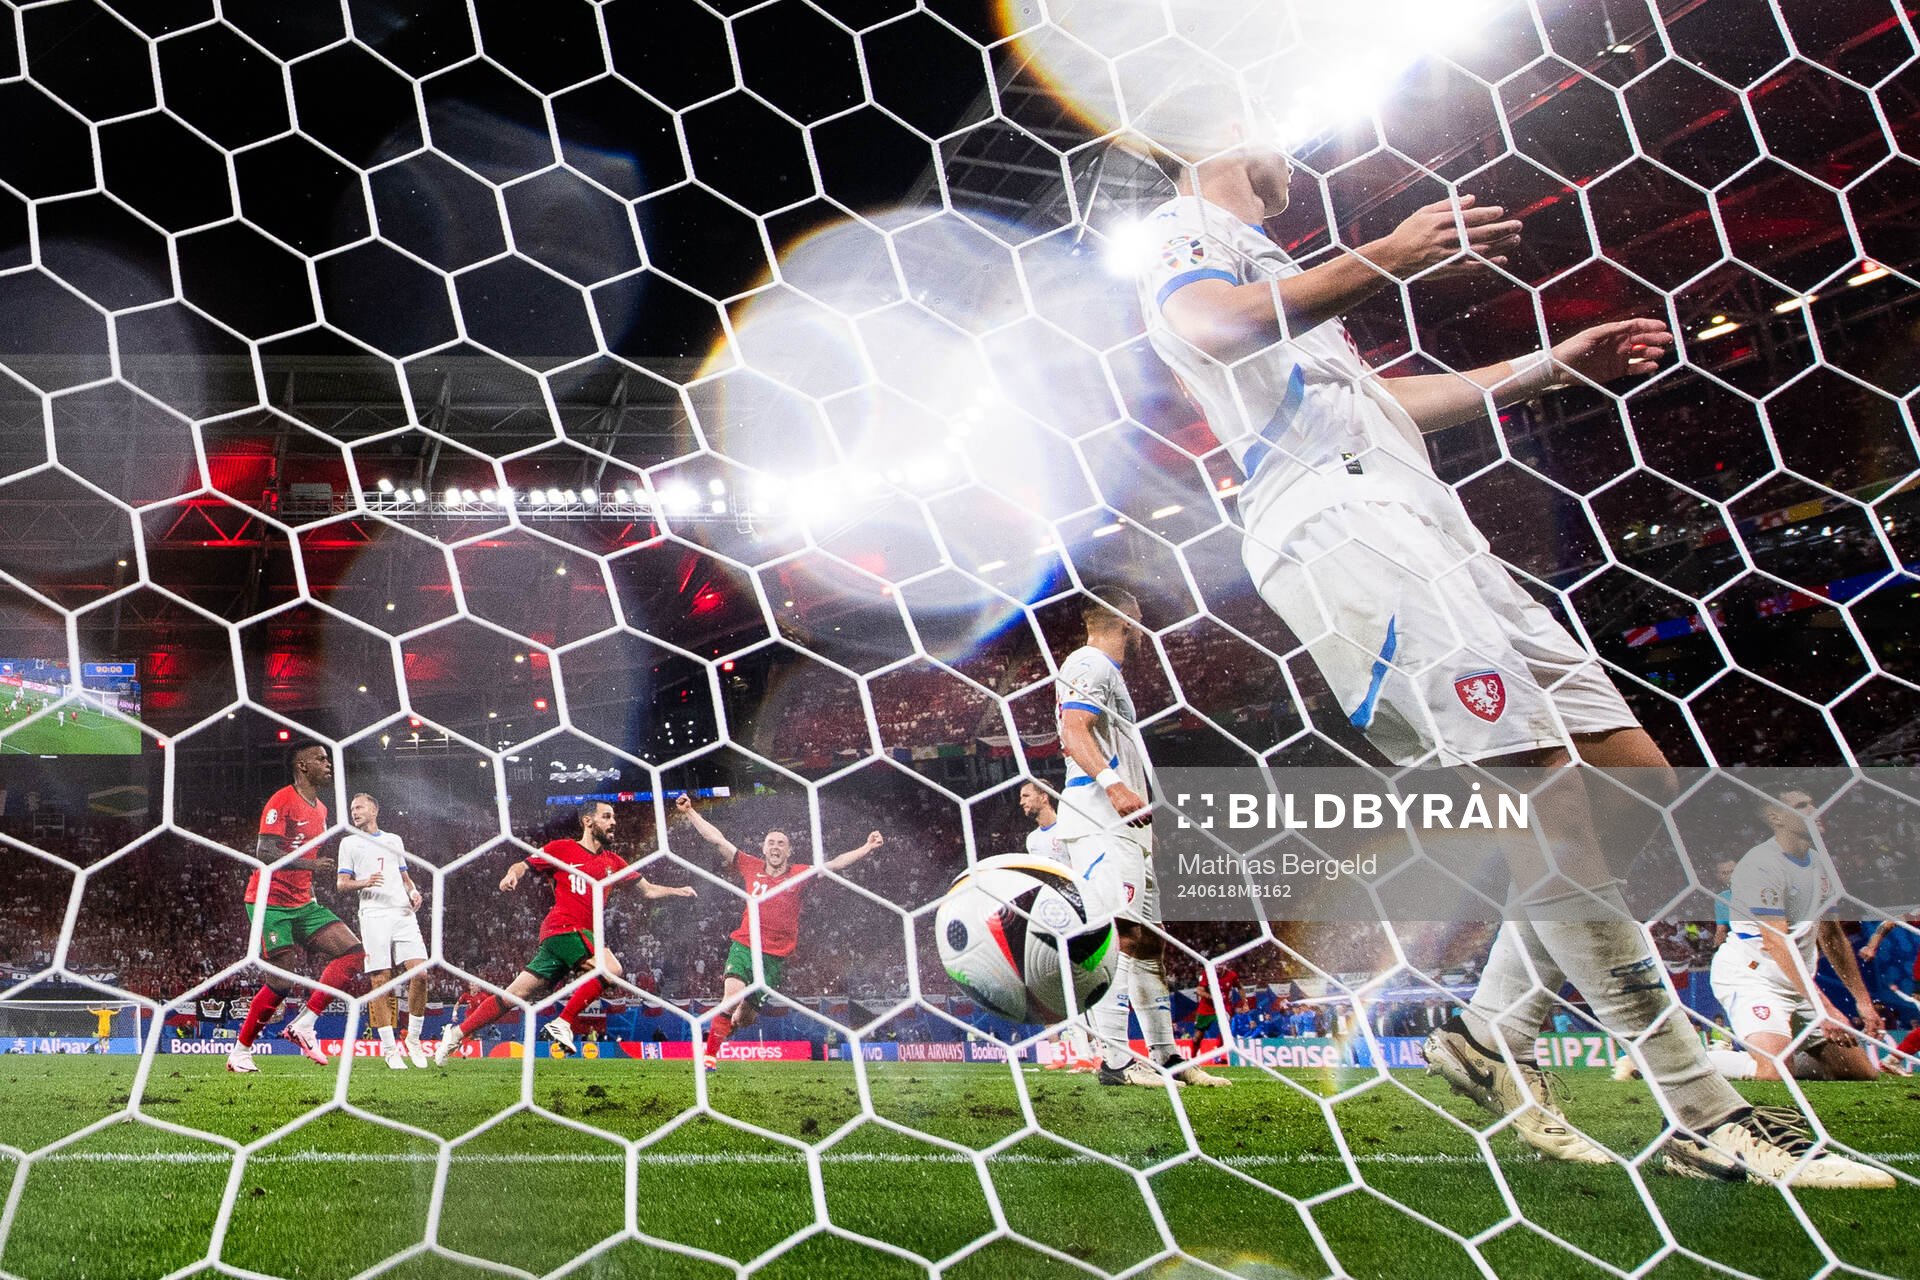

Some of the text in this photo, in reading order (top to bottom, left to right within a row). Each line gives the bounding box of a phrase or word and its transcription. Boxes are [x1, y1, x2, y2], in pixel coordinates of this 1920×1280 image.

[377, 857, 384, 871] 7
[569, 873, 586, 896] 10
[40, 1040, 92, 1054] Alipay
[171, 1038, 272, 1054] Bookingom
[354, 1041, 443, 1057] STAS
[900, 1043, 963, 1062] QATAR AIRWAYS
[971, 1043, 1028, 1063] Bookingm
[1237, 1039, 1340, 1067] Hisense
[1534, 1037, 1618, 1067] EIPZI
